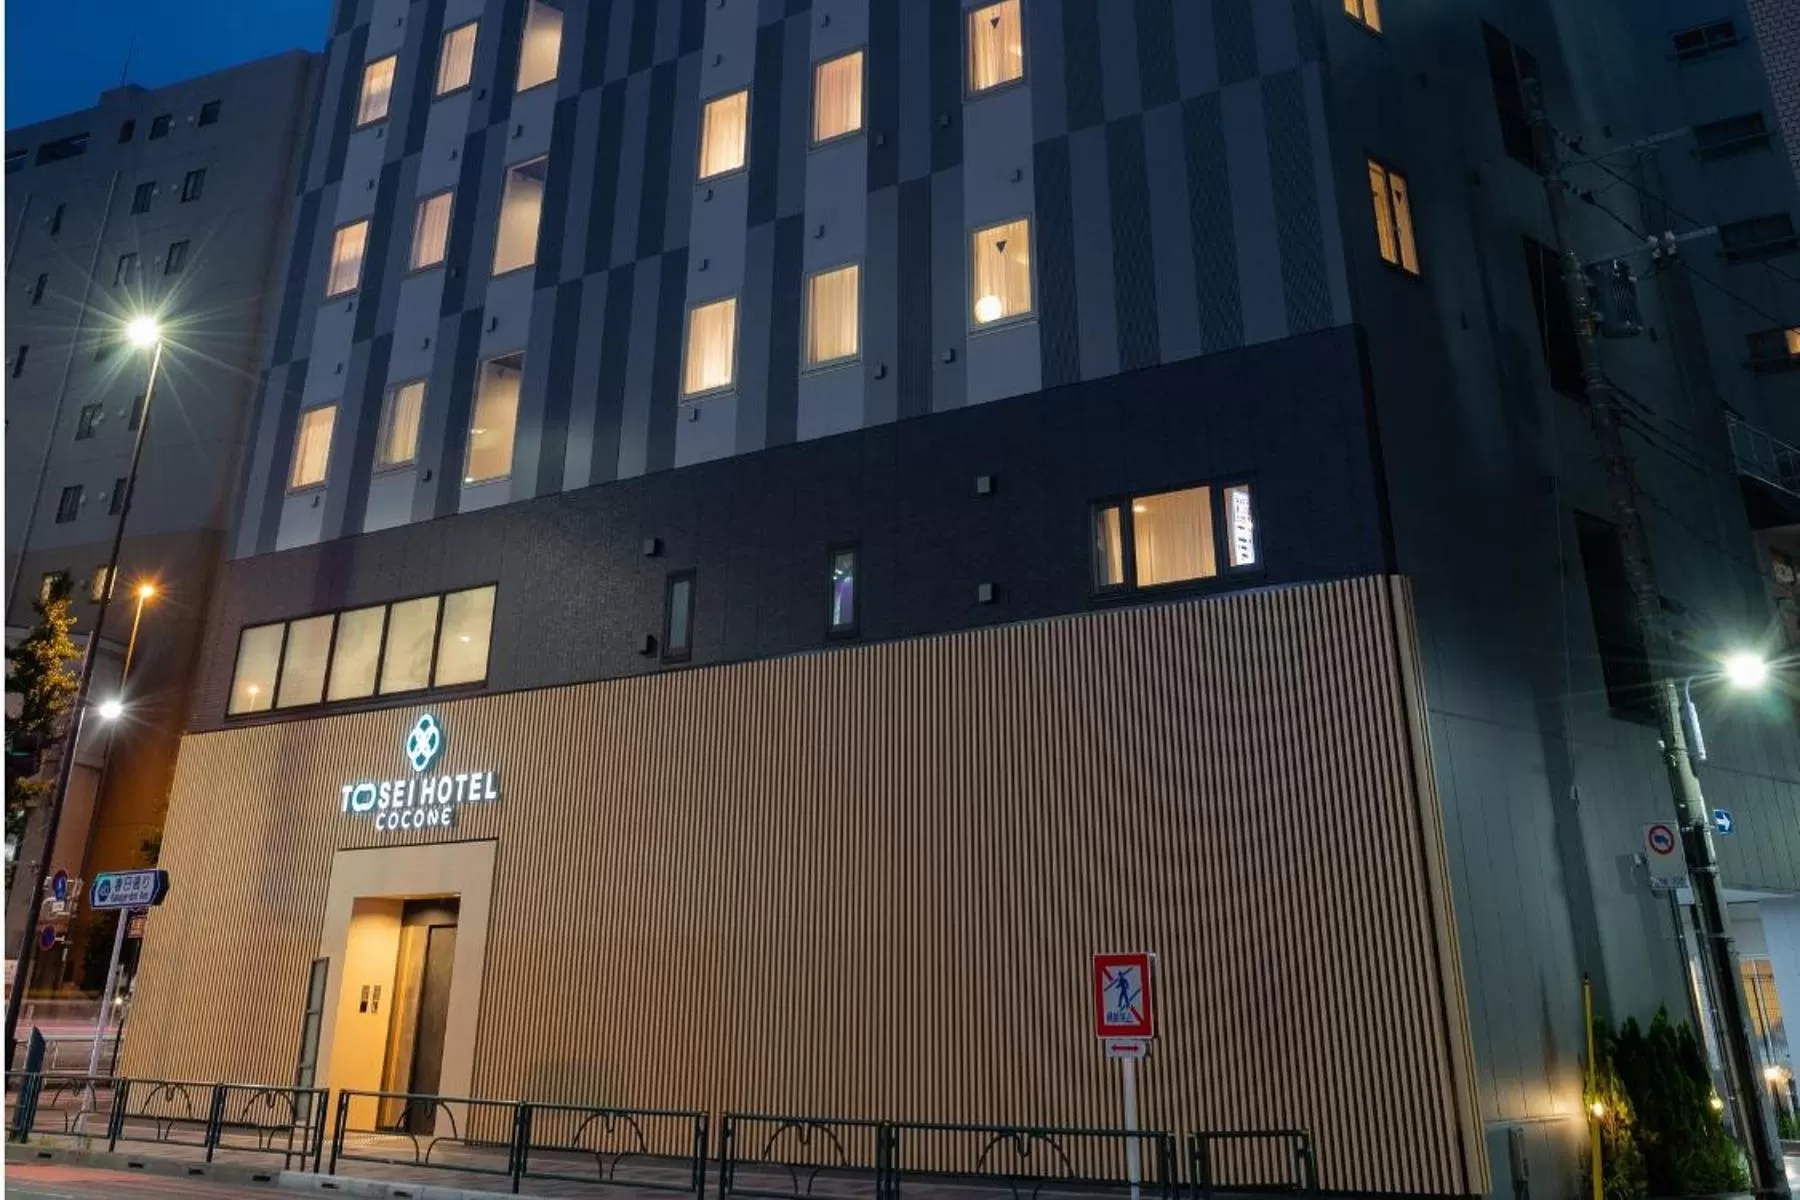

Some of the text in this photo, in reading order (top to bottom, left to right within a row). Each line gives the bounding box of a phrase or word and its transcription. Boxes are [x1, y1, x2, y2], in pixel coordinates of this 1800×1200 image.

[341, 771, 498, 812] TOSEI HOTEL
[375, 807, 452, 831] COCONE
